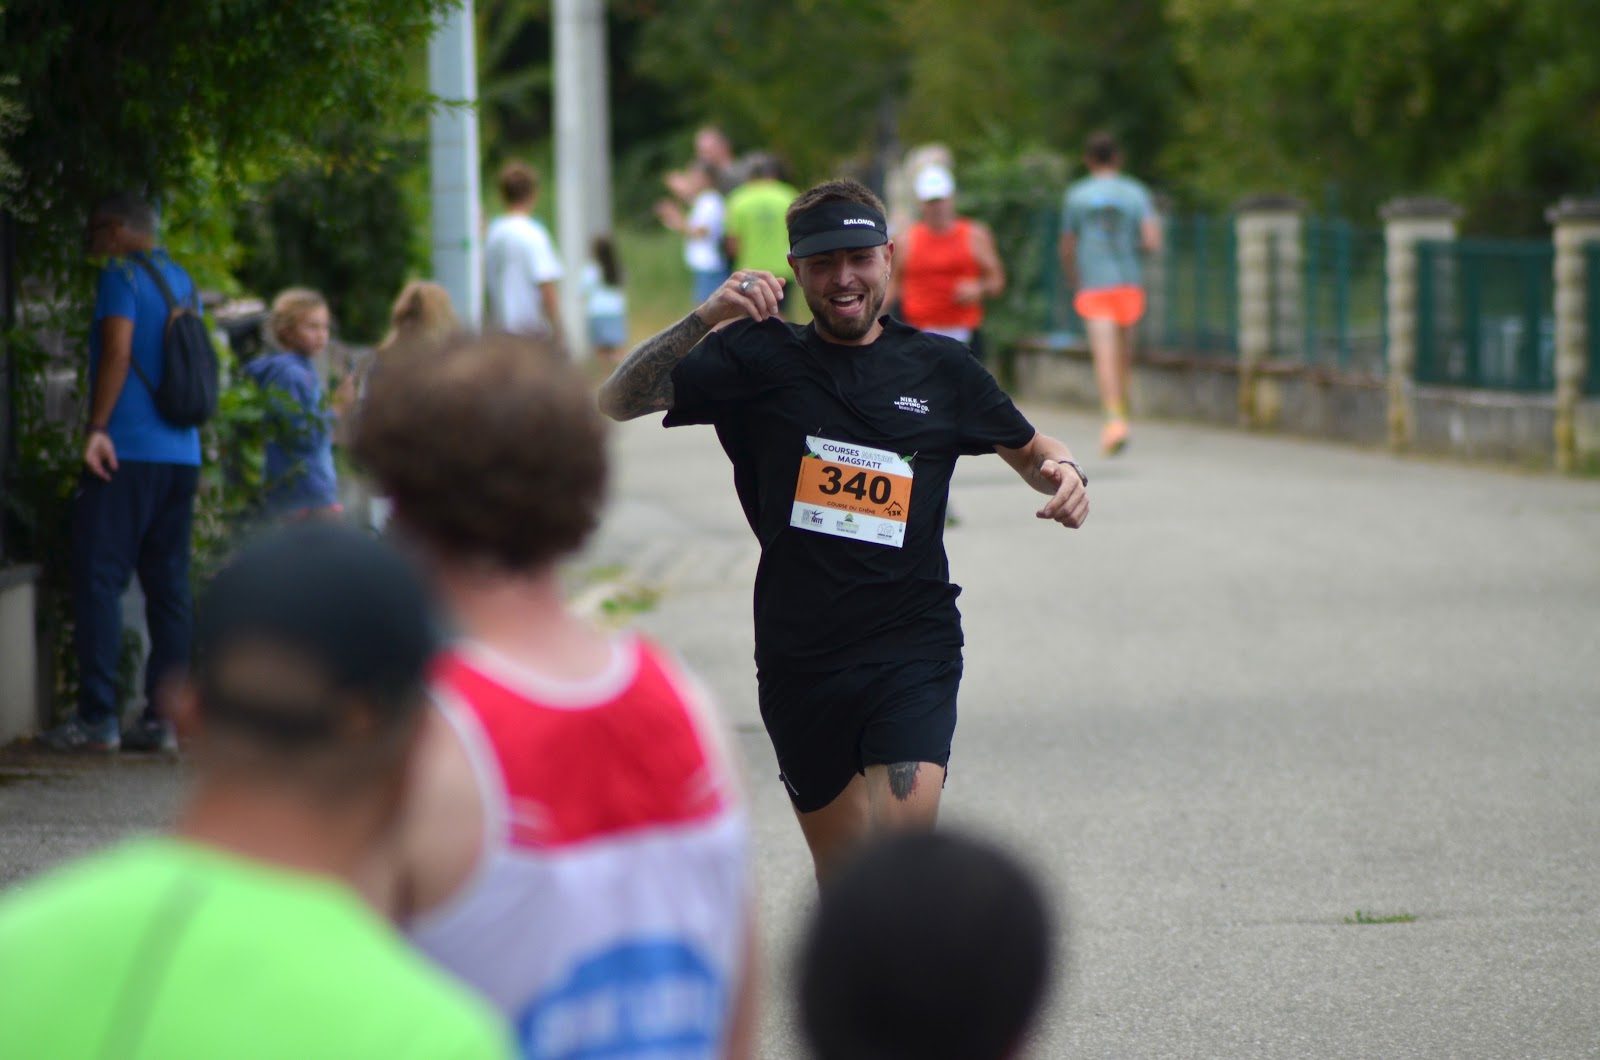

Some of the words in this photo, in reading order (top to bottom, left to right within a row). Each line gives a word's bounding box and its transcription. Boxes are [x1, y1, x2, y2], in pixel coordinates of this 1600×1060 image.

[843, 219, 875, 227] SALOMON
[822, 443, 860, 457] COURSES
[837, 455, 882, 469] MAGSTATT
[818, 466, 892, 505] 340
[826, 501, 848, 509] COURSE
